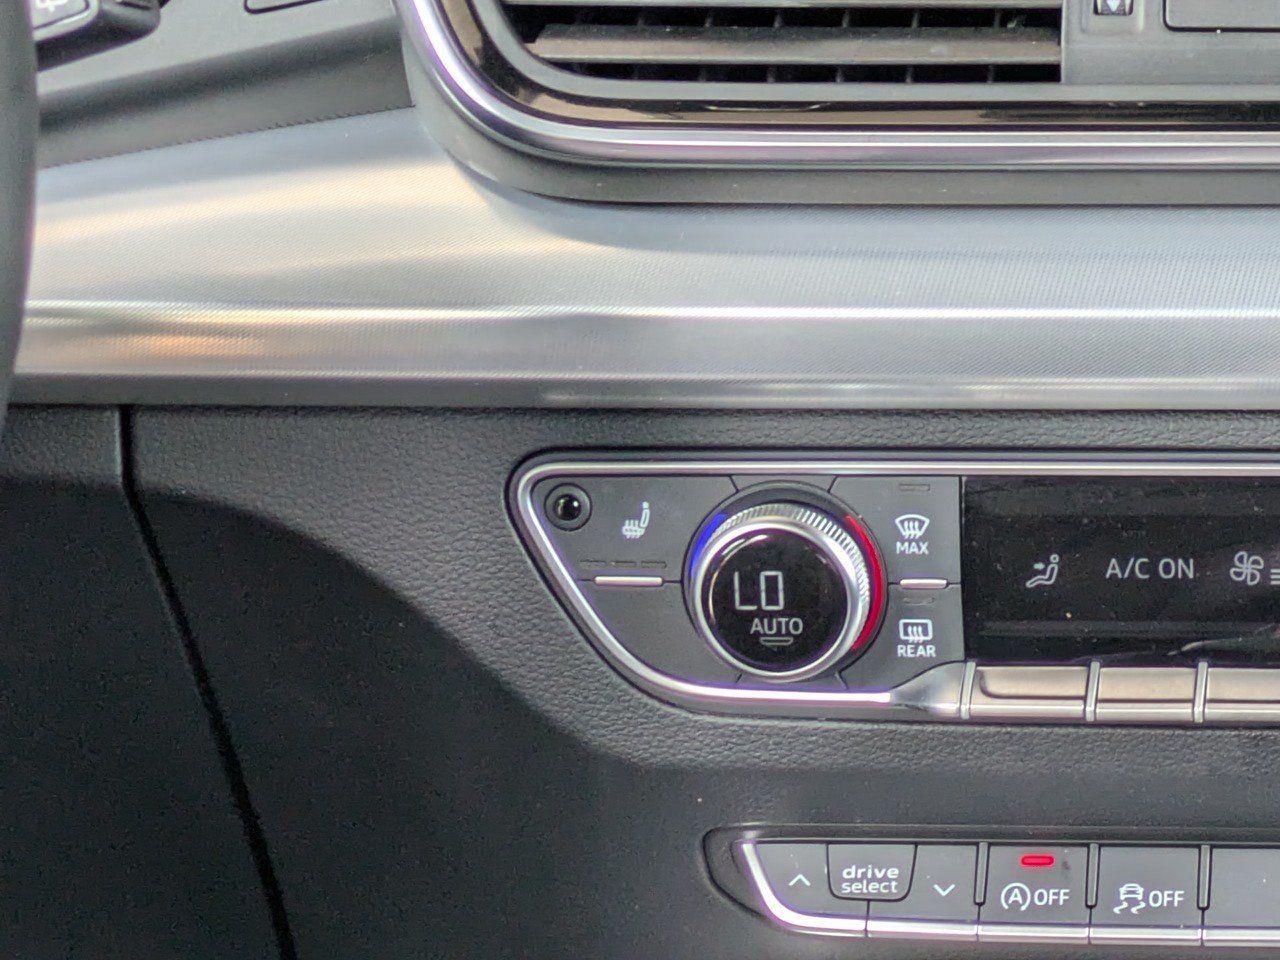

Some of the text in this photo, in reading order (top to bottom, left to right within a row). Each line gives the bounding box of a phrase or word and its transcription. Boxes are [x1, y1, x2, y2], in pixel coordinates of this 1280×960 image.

[895, 541, 929, 555] MAX
[1105, 558, 1194, 579] A/C ON
[750, 617, 804, 635] AUTO
[897, 644, 936, 658] REAR
[841, 865, 899, 880] drive
[841, 880, 898, 894] select
[1034, 890, 1070, 906] OFF
[1149, 891, 1185, 907] OFF
